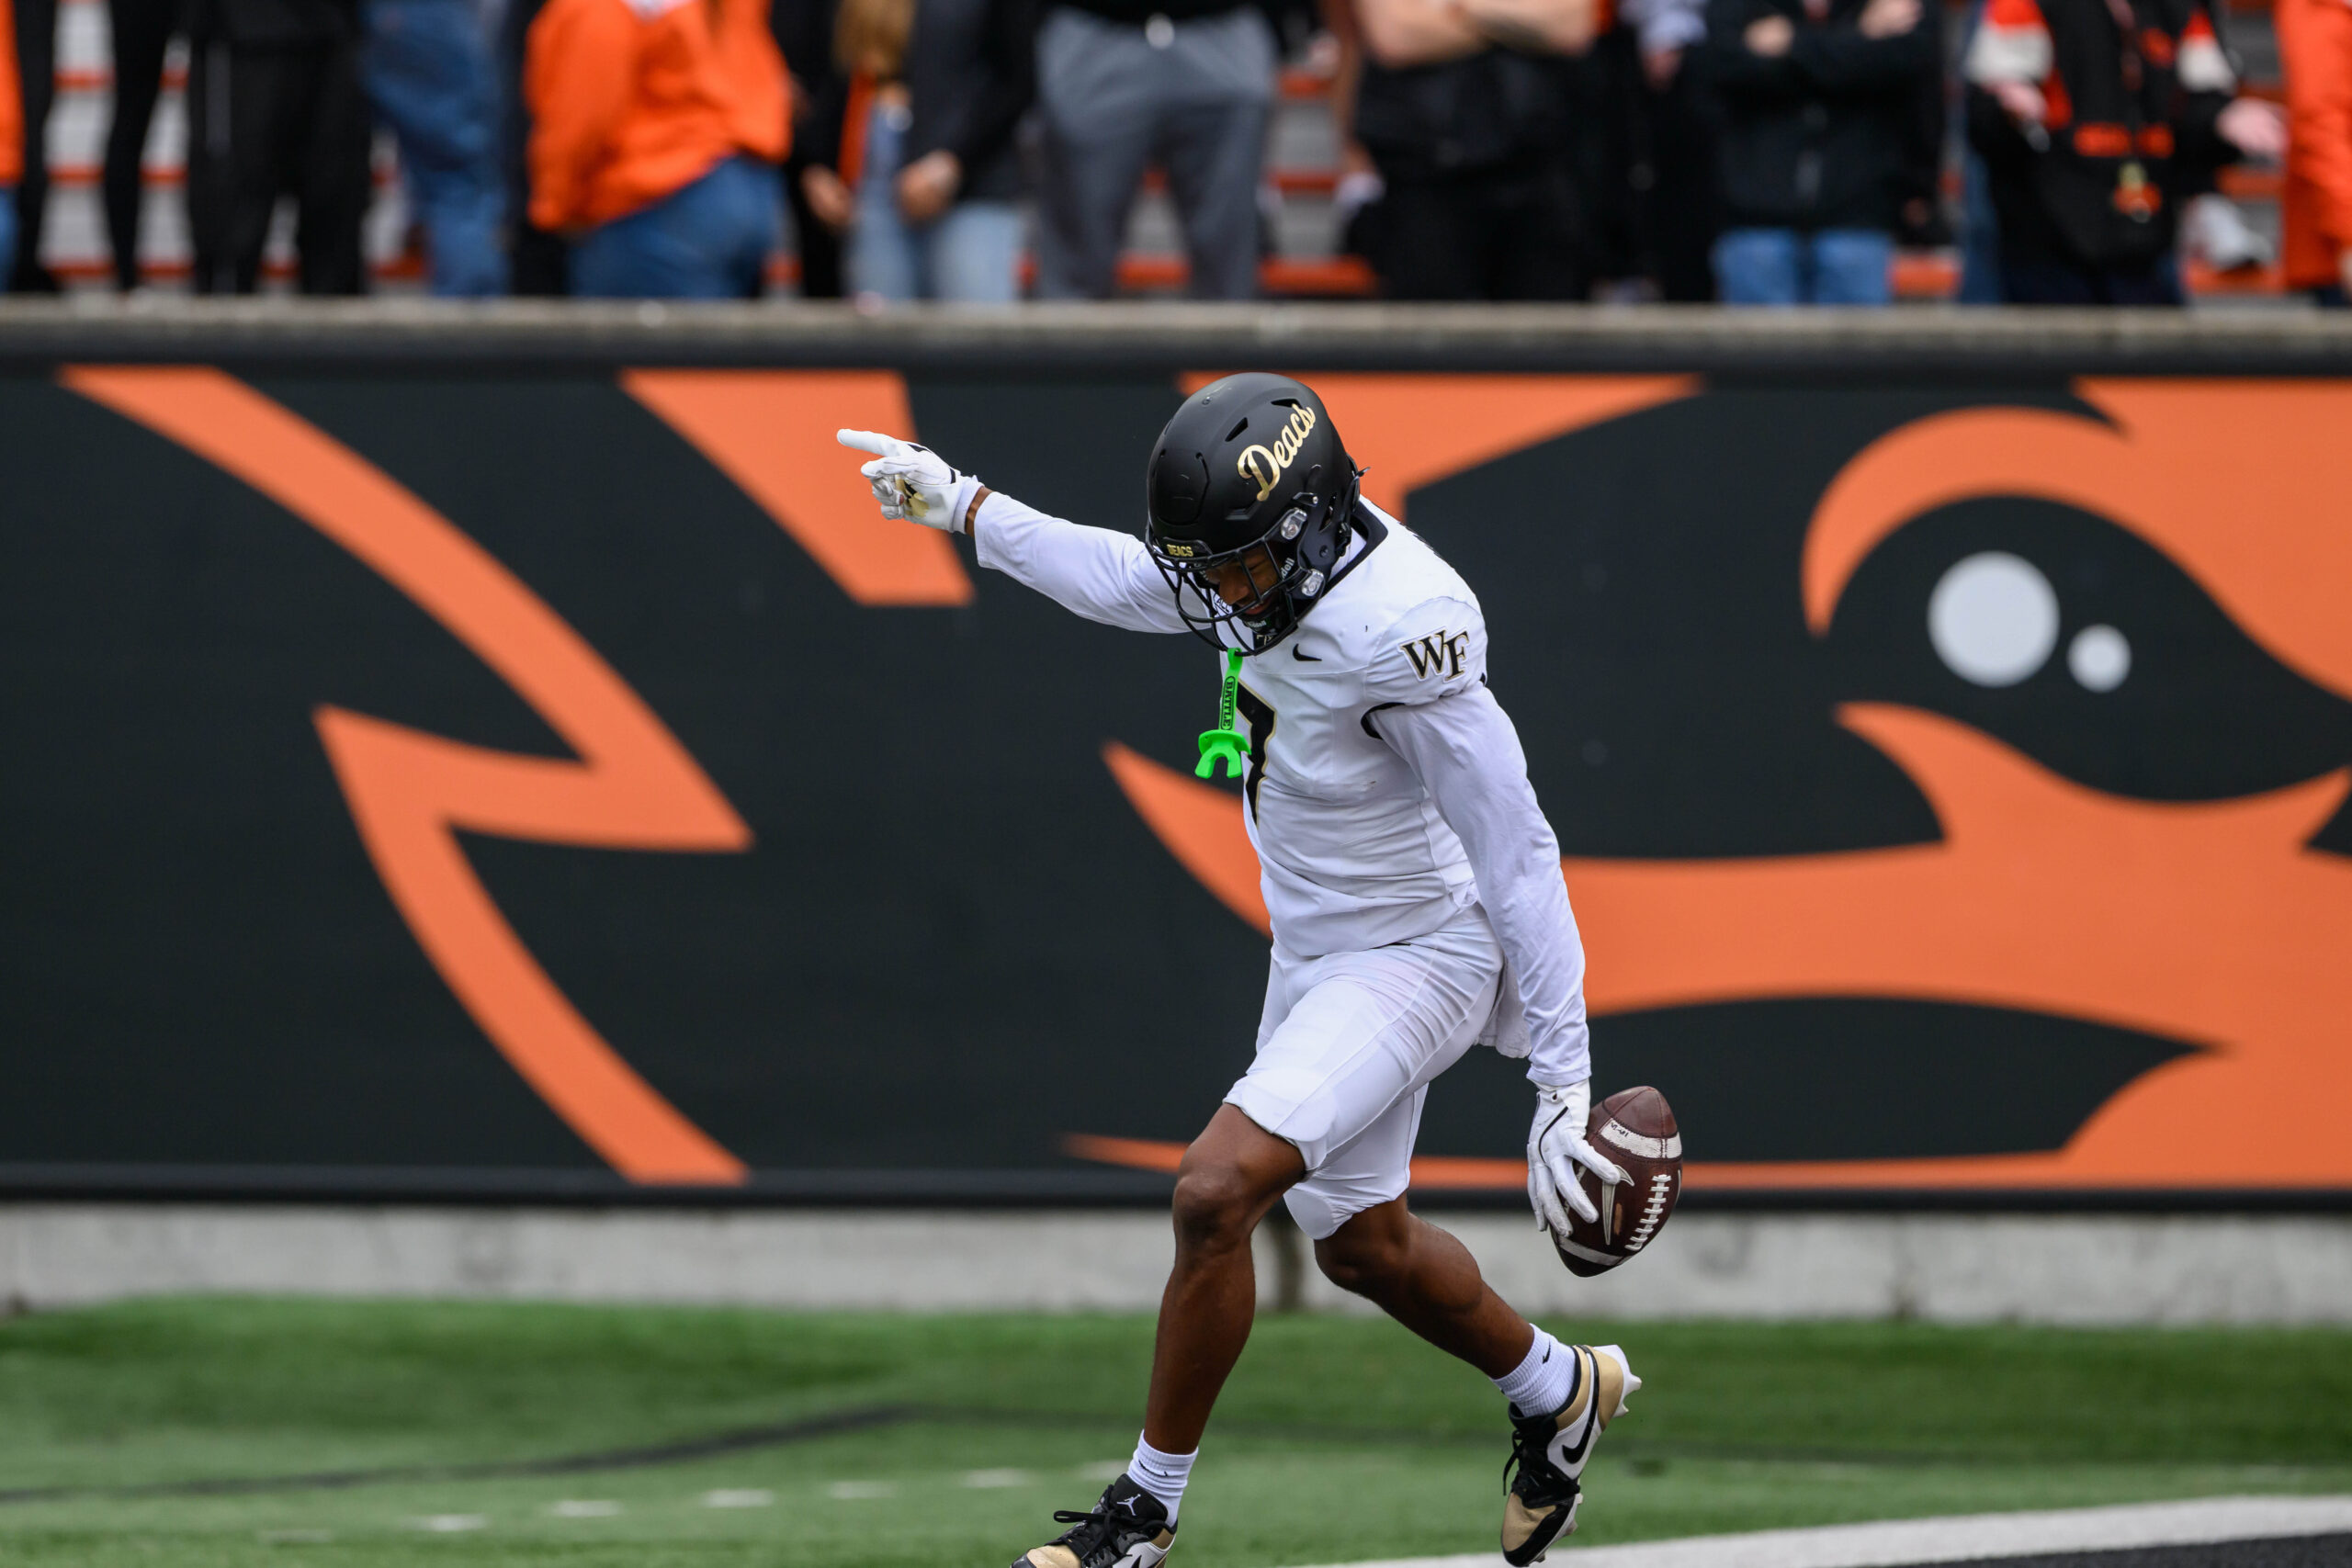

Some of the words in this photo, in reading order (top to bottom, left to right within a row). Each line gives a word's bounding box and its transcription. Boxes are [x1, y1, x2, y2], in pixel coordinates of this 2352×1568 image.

[1238, 403, 1316, 502] Deacs
[1167, 544, 1193, 557] DEACS
[1399, 629, 1470, 682] WF
[1224, 681, 1233, 728] BATTLE
